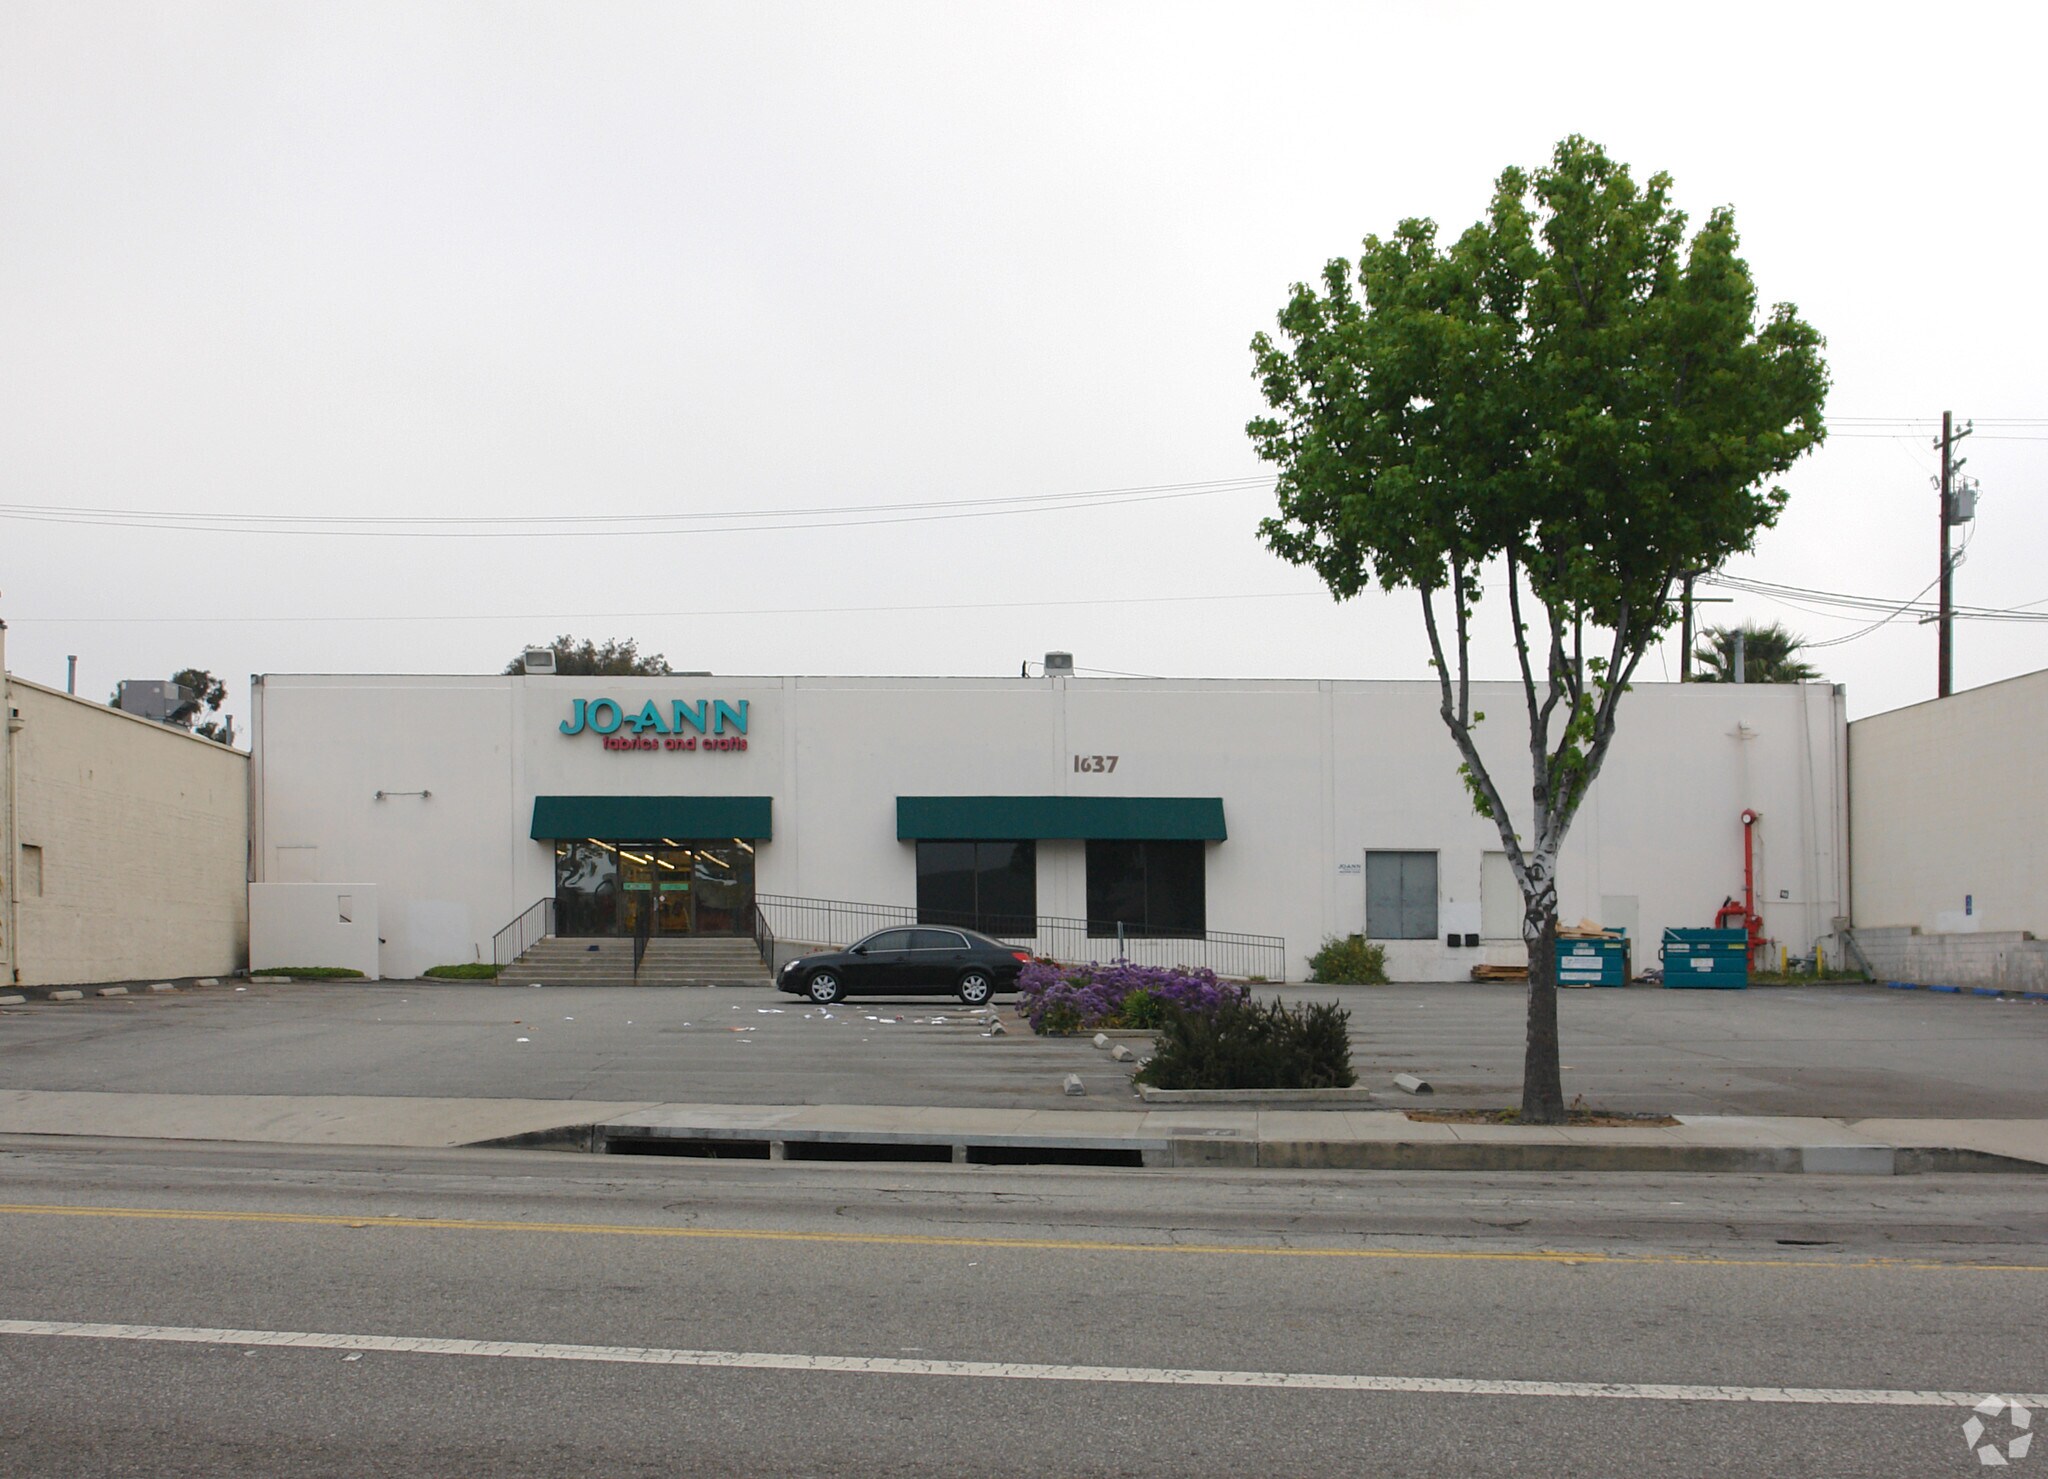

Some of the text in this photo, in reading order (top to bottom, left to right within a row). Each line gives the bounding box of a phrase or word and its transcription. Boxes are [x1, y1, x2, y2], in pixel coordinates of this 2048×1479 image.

[603, 736, 748, 751] fabrics and crafts
[1074, 755, 1119, 773] 1637
